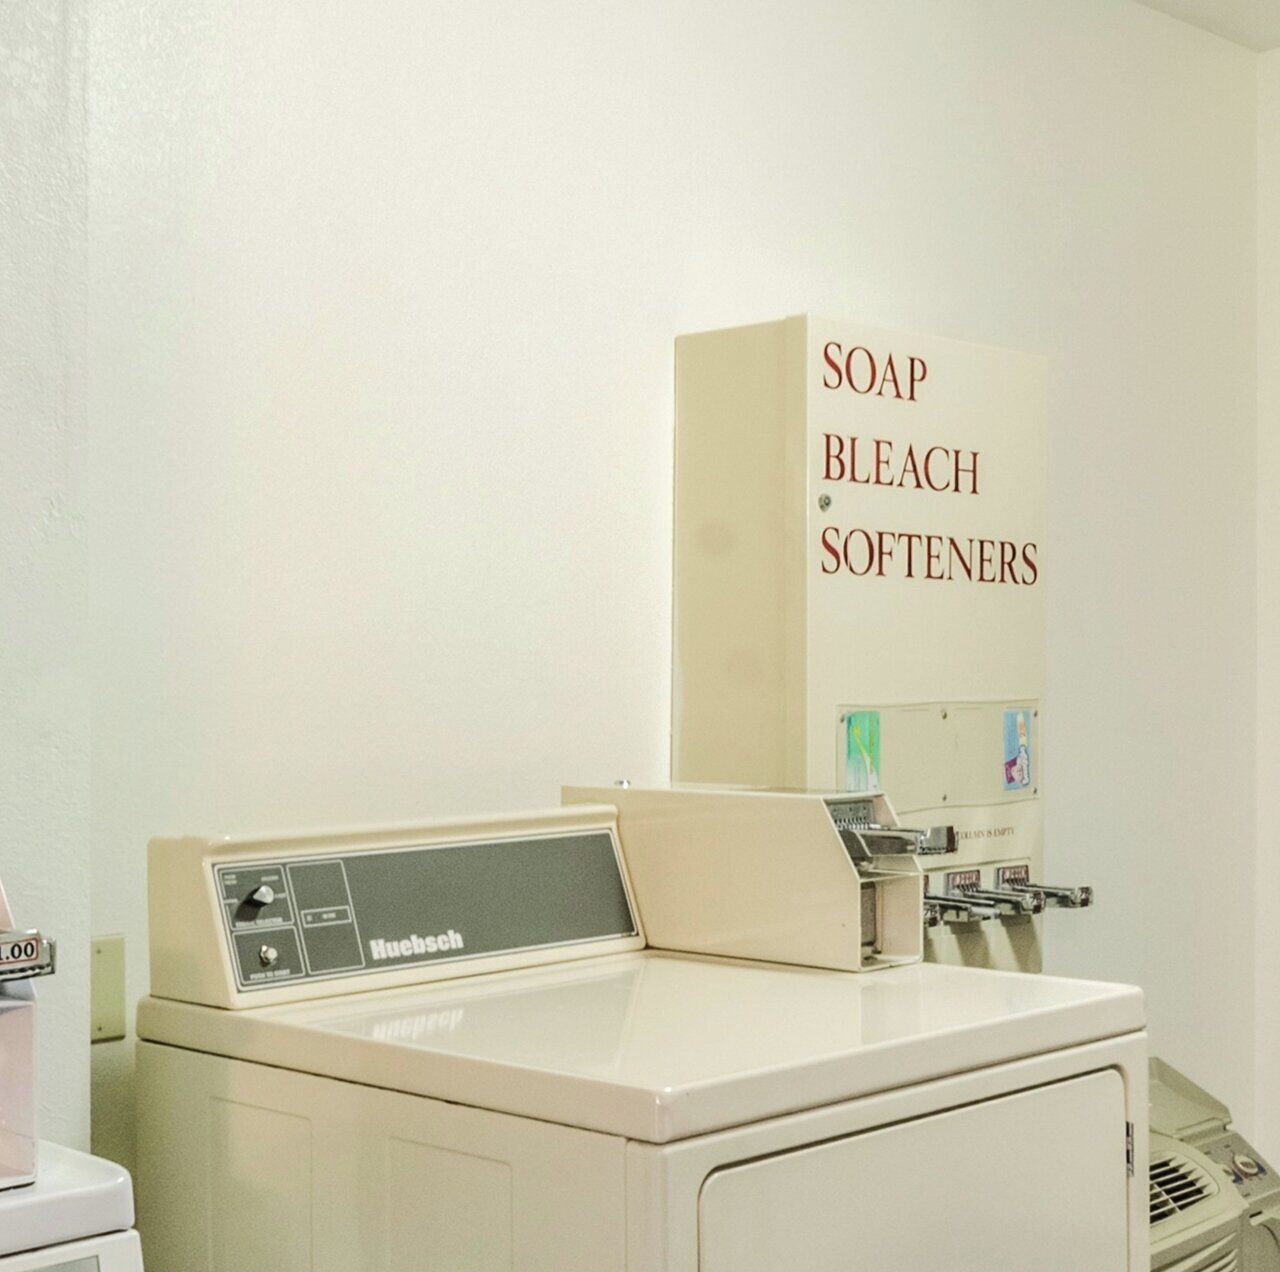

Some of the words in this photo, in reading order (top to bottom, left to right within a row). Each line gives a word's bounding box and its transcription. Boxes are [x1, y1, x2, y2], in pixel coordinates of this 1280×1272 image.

[823, 341, 927, 402] SOAP
[822, 433, 979, 495] BLEACH
[821, 526, 1038, 586] SOFTENERS
[369, 929, 464, 960] Huebsch
